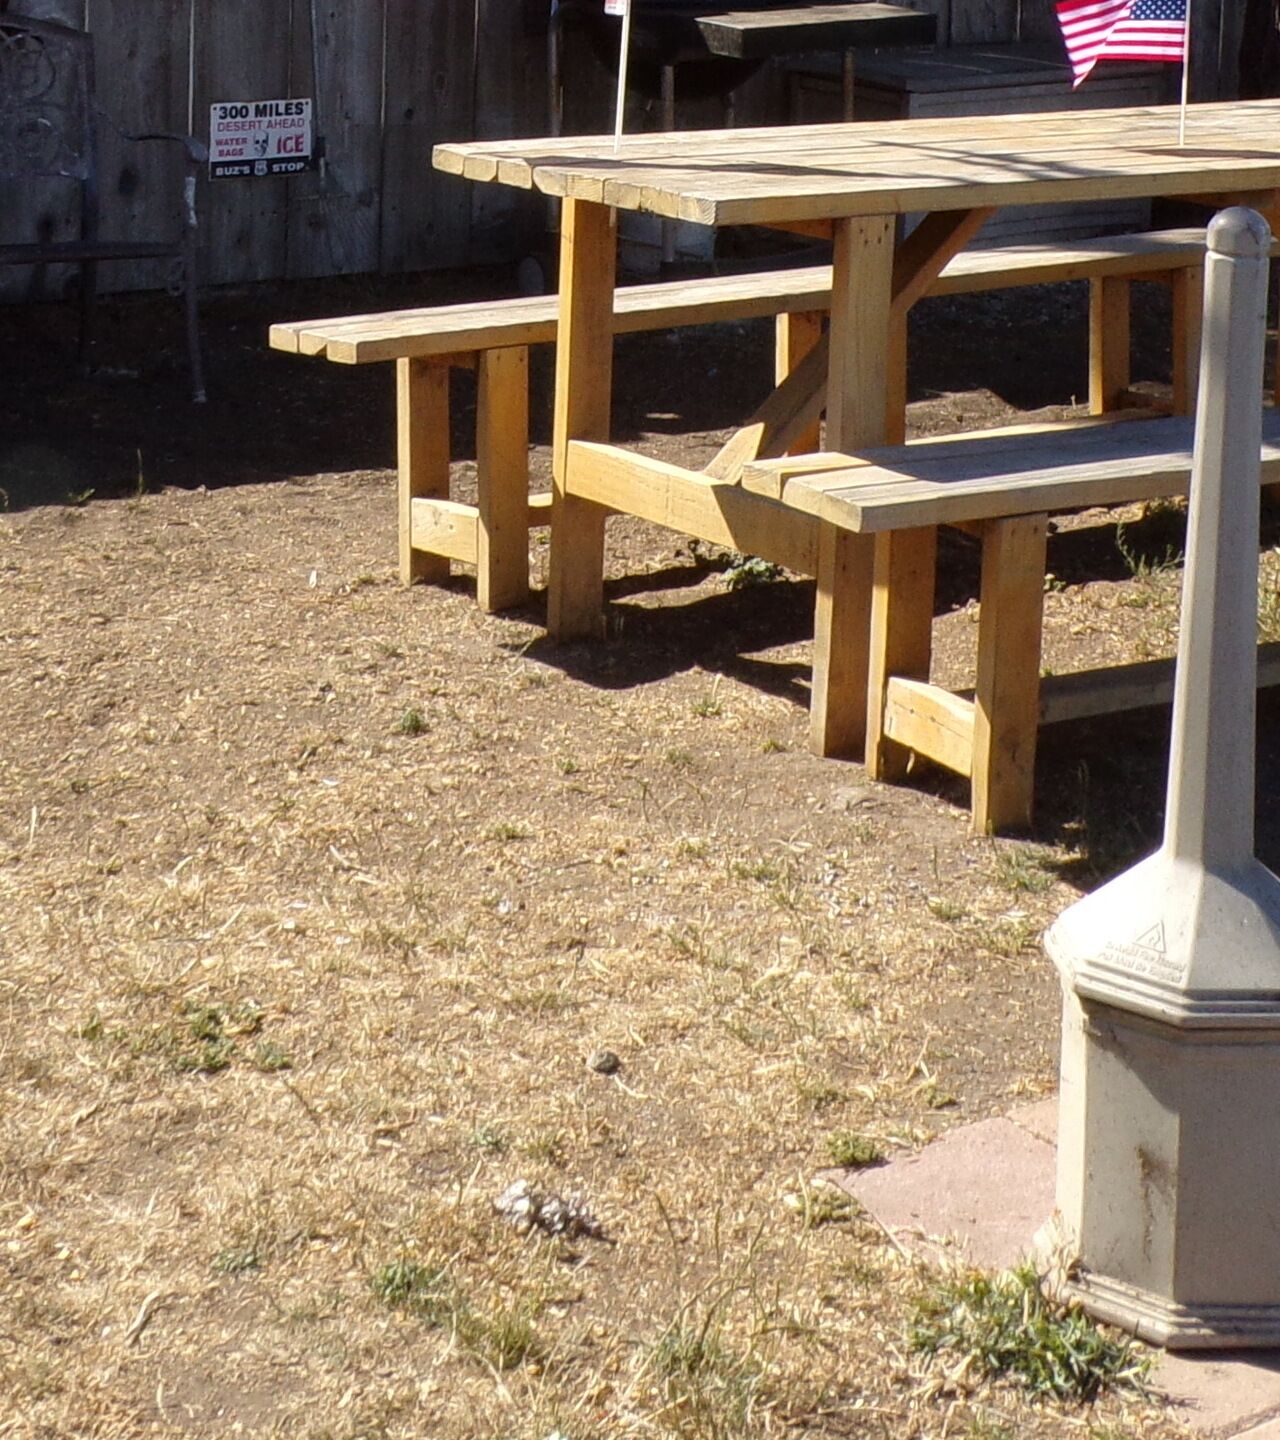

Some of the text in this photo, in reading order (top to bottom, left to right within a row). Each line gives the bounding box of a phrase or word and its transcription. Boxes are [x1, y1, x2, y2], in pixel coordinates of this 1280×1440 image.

[220, 102, 304, 120] 300 MILES
[217, 118, 305, 133] DESERT AHEAD
[215, 137, 248, 147] WATER
[276, 133, 305, 154] ICE
[218, 148, 244, 157] BAGS
[272, 162, 305, 172] STOP
